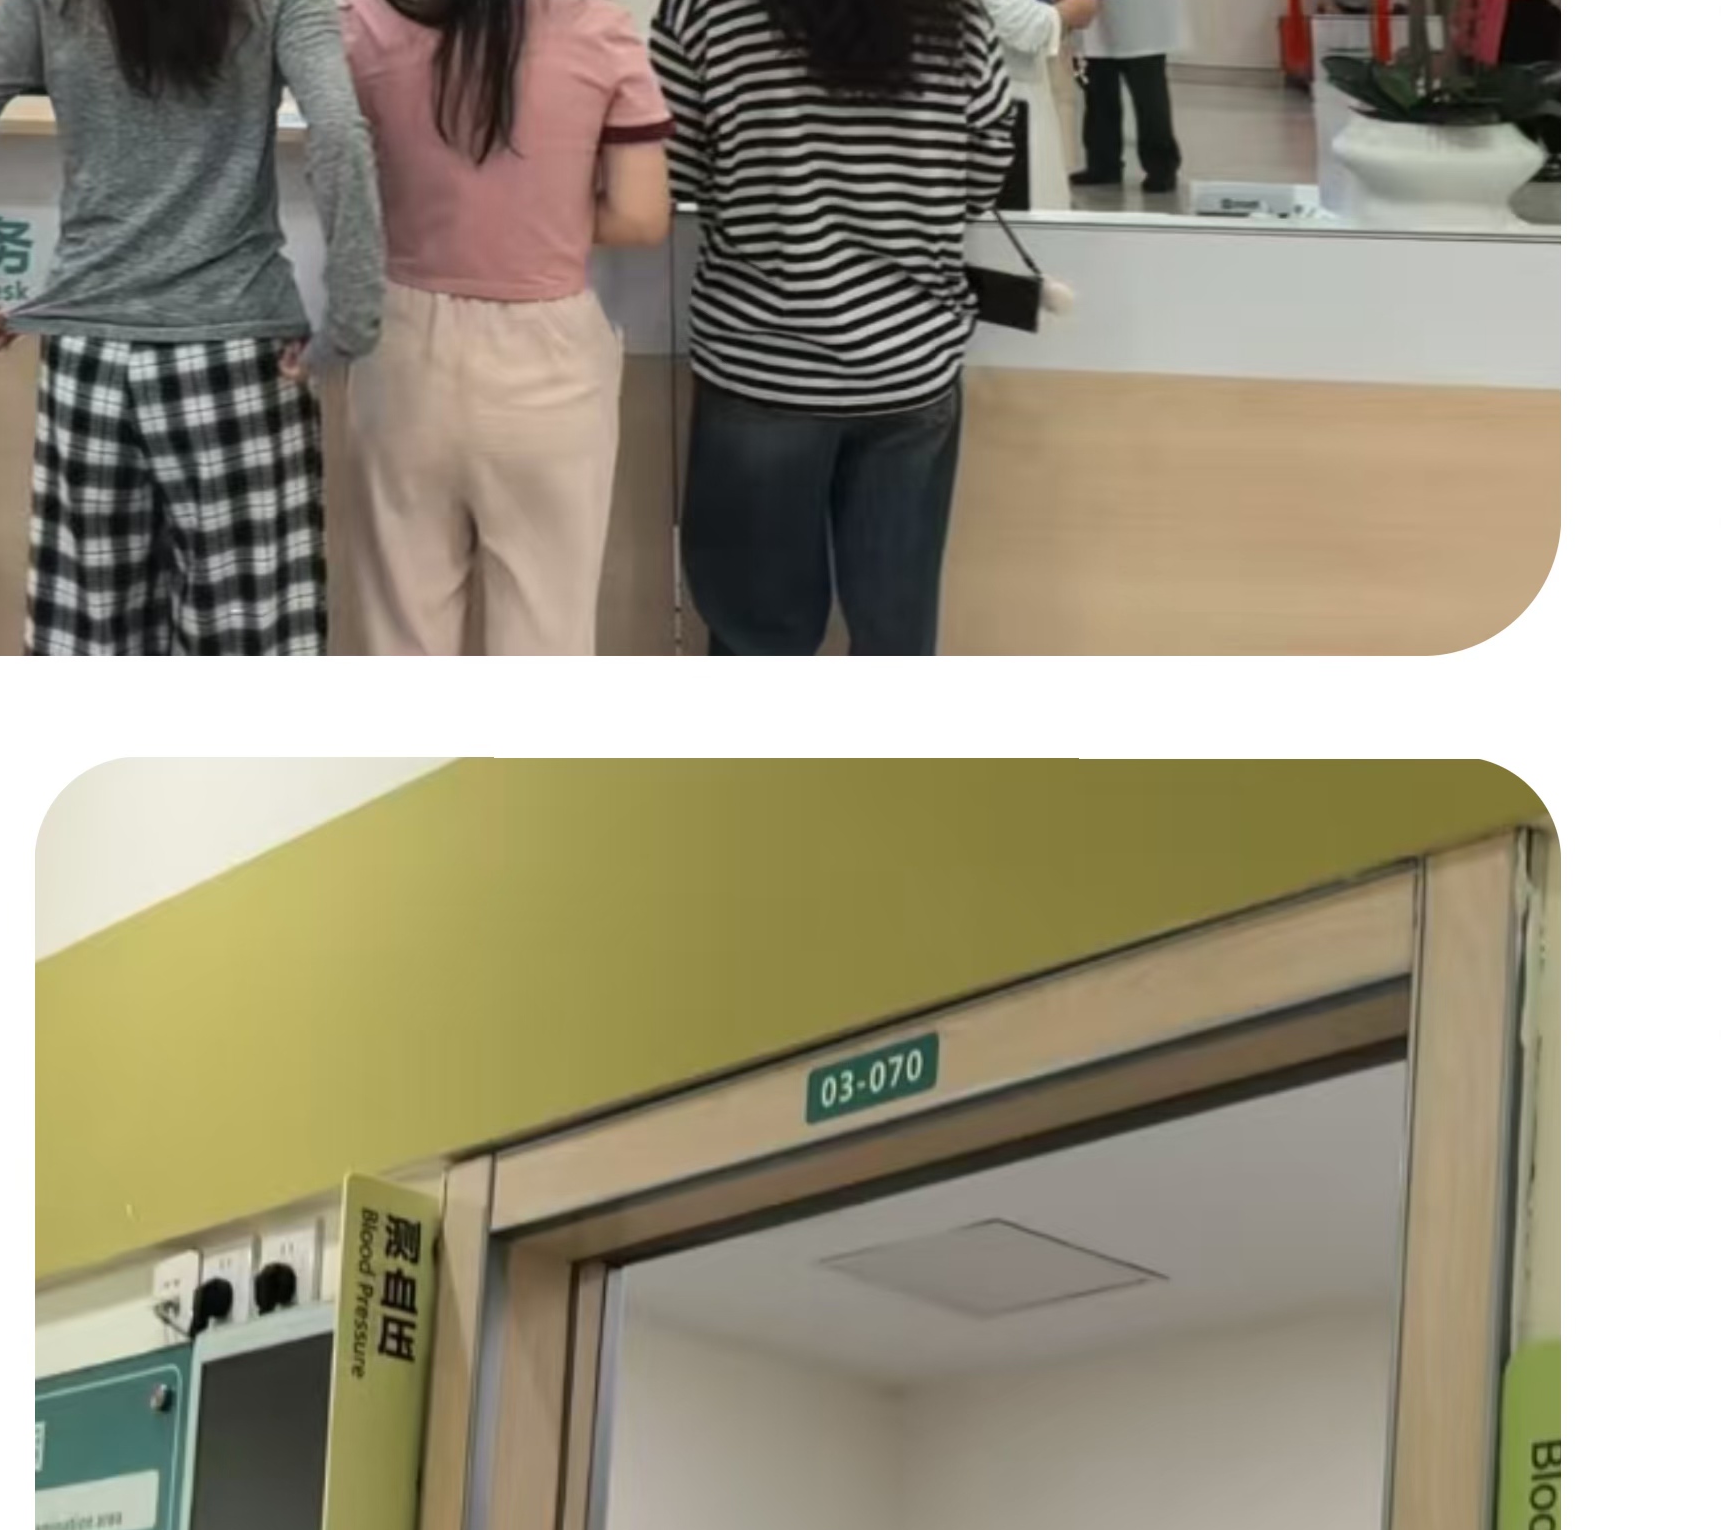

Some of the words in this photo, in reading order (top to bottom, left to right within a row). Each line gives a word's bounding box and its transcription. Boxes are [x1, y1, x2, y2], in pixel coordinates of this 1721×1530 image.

[820, 1048, 924, 1108] 03-070
[358, 1207, 380, 1276] Blood
[378, 1213, 422, 1363] 测血压
[351, 1281, 375, 1380] Pressure
